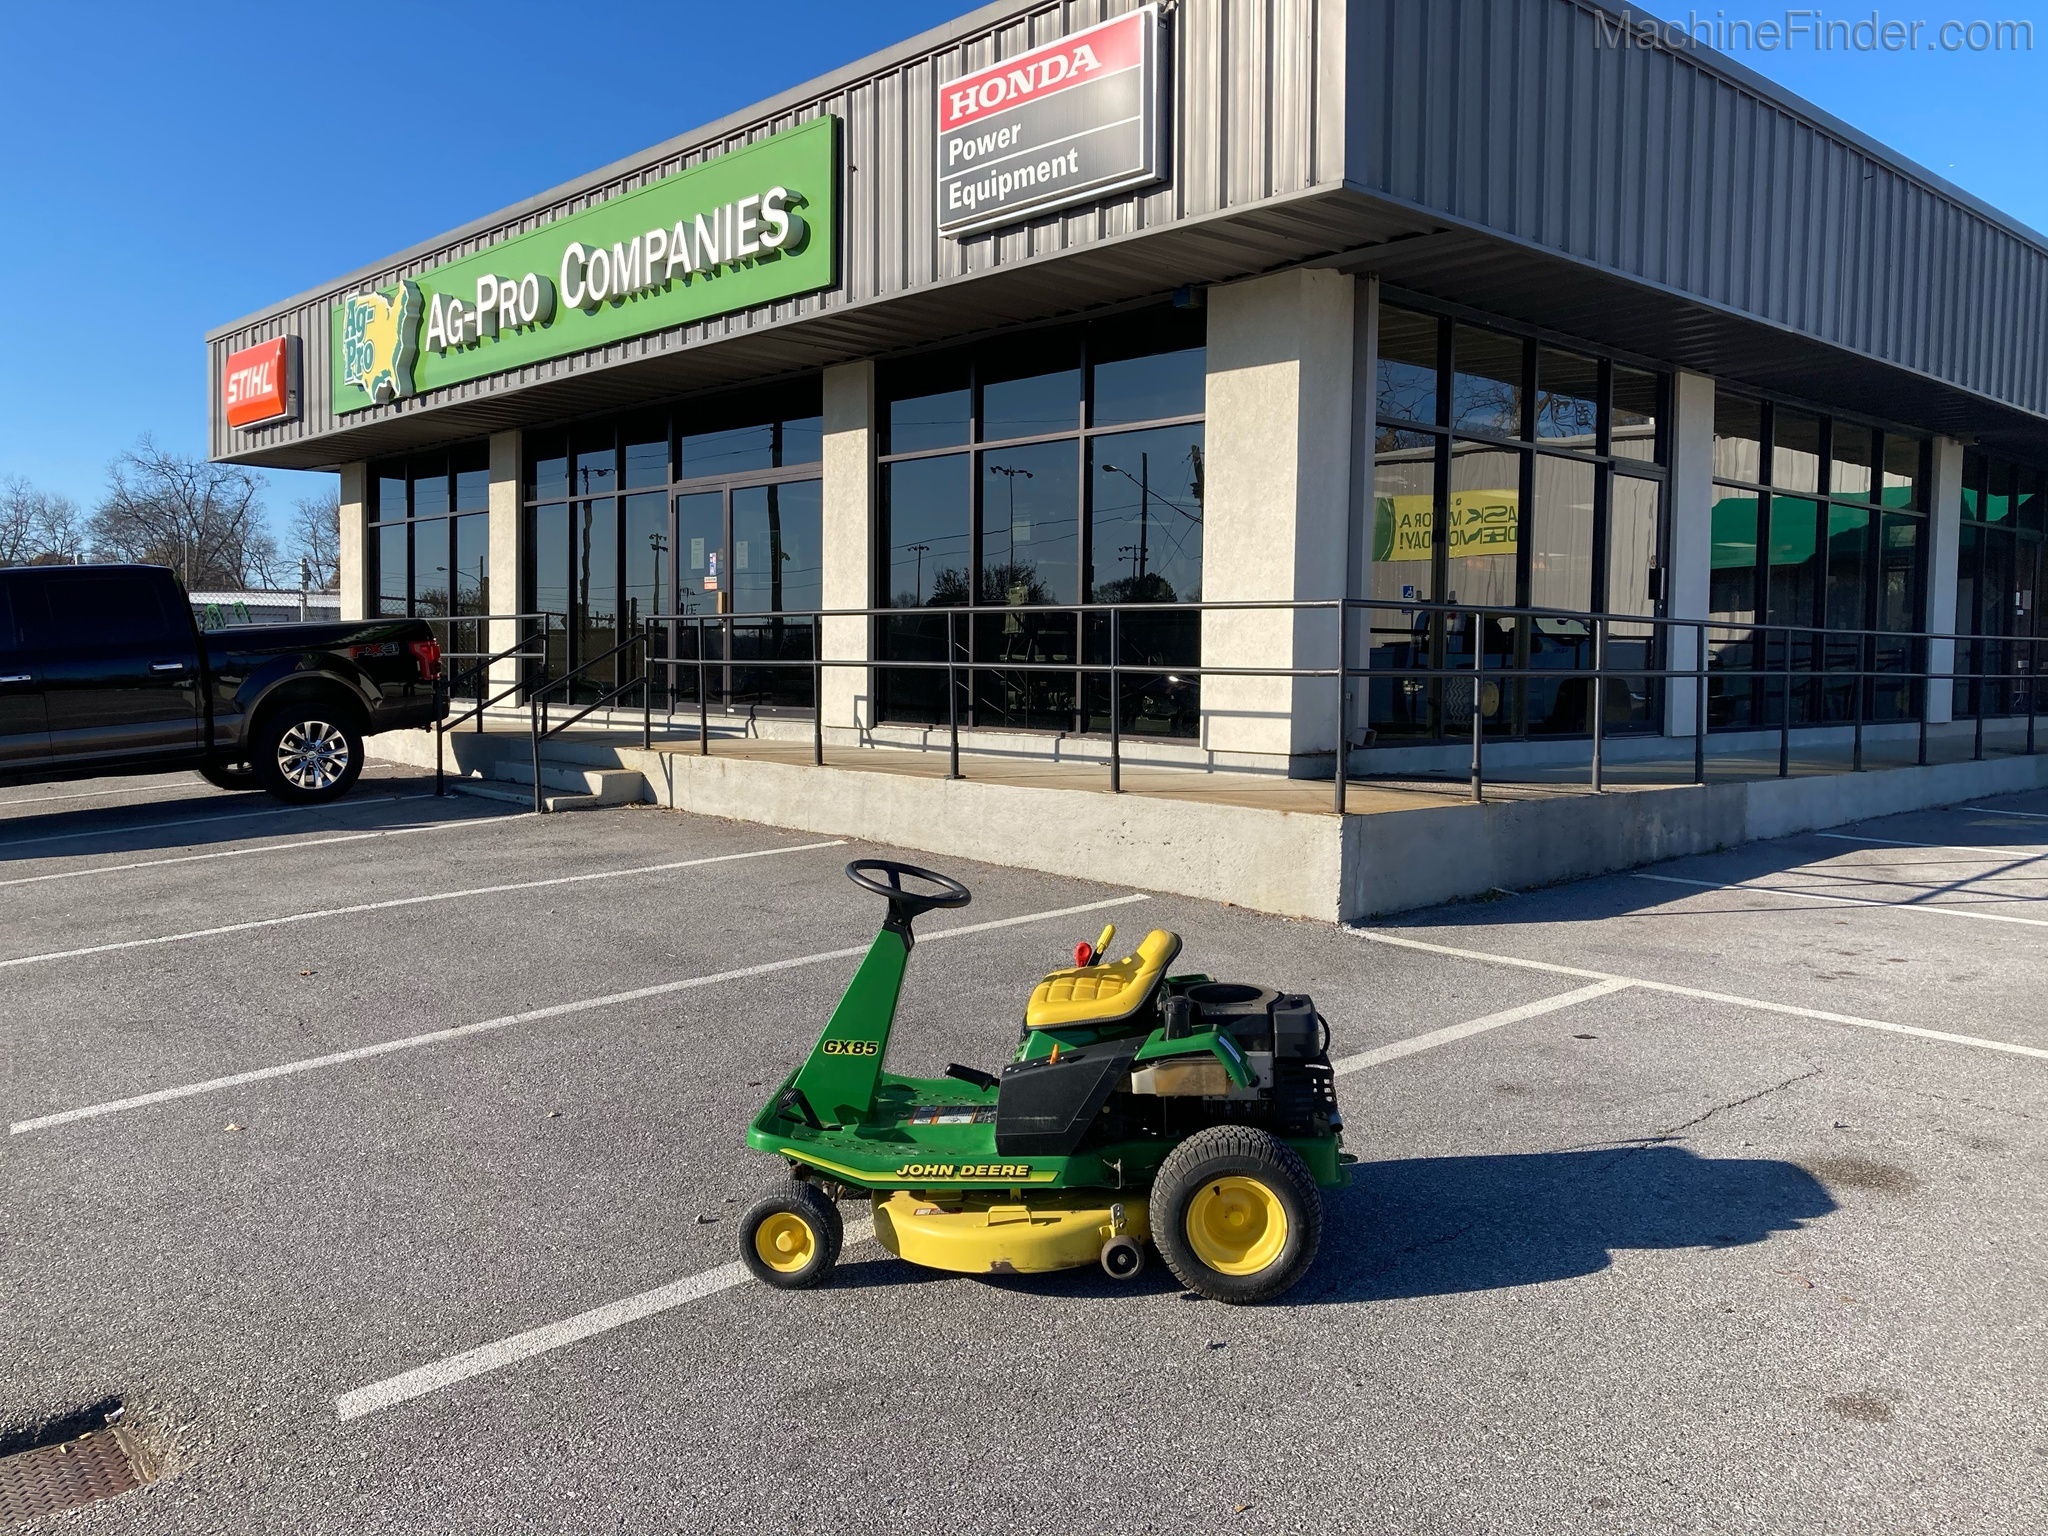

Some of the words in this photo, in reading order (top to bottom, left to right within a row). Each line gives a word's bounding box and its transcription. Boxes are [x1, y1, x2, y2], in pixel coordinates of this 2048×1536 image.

[949, 44, 1102, 121] HONDA
[949, 123, 1022, 167] Power
[949, 147, 1079, 210] Equipment
[345, 297, 375, 343] Ag-
[344, 340, 375, 382] Pro
[227, 363, 273, 404] STIHL
[348, 642, 400, 659] FX4
[823, 1039, 879, 1056] GX85
[896, 1164, 955, 1178] JOHN
[960, 1164, 1031, 1178] DEERE
